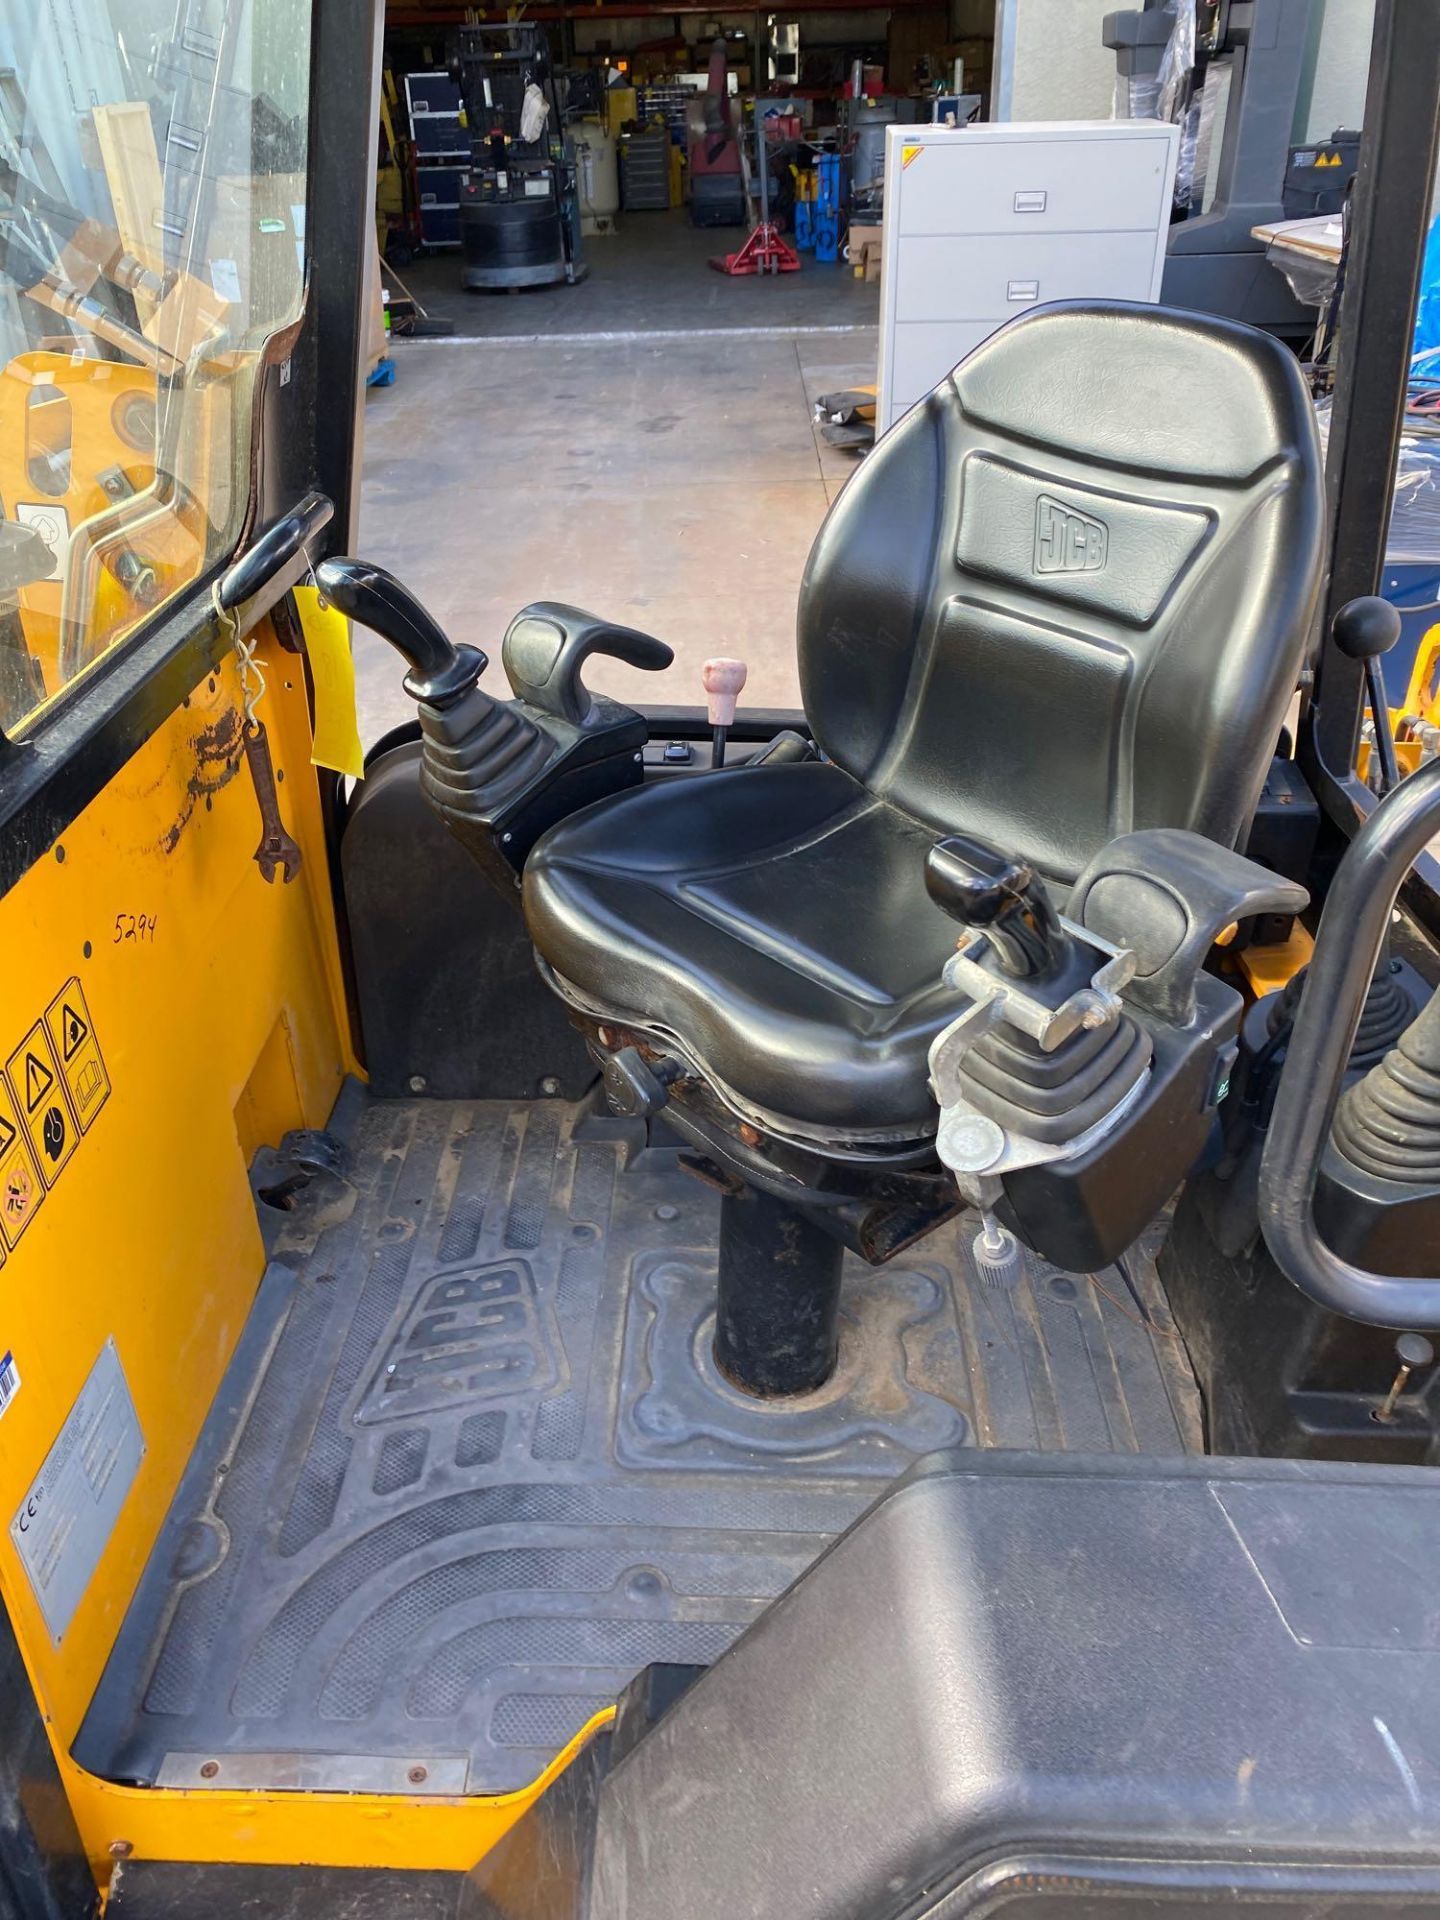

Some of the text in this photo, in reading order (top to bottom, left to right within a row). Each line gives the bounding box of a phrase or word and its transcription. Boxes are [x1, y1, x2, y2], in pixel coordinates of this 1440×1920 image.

[1036, 499, 1104, 573] JCB
[113, 913, 157, 944] 5294
[384, 1269, 536, 1393] JCB
[20, 1498, 37, 1532] CE
